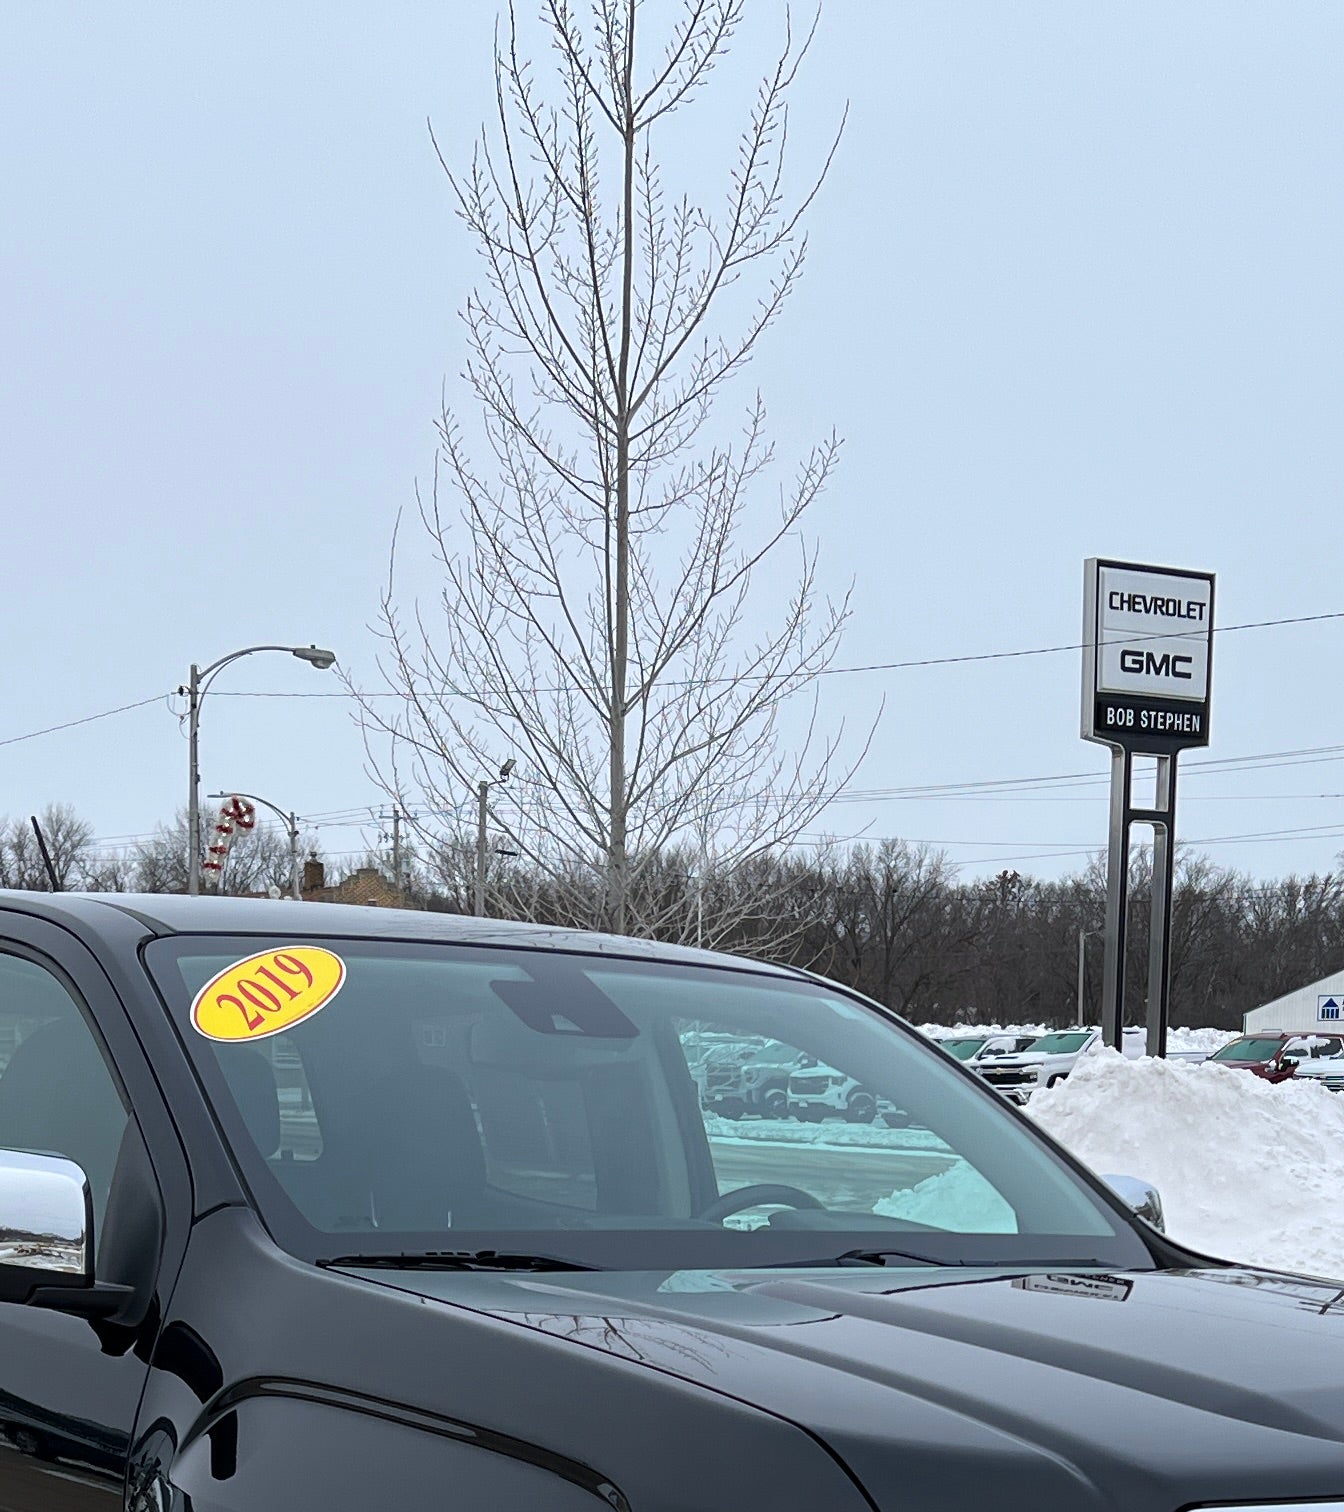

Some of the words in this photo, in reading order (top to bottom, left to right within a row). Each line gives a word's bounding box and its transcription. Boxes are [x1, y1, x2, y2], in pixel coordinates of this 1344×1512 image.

[1108, 590, 1207, 621] CHEVROLET
[1120, 649, 1193, 680] GMC
[1106, 706, 1135, 727] BOB
[1140, 709, 1201, 733] STEPHEN
[215, 953, 313, 1032] 2019
